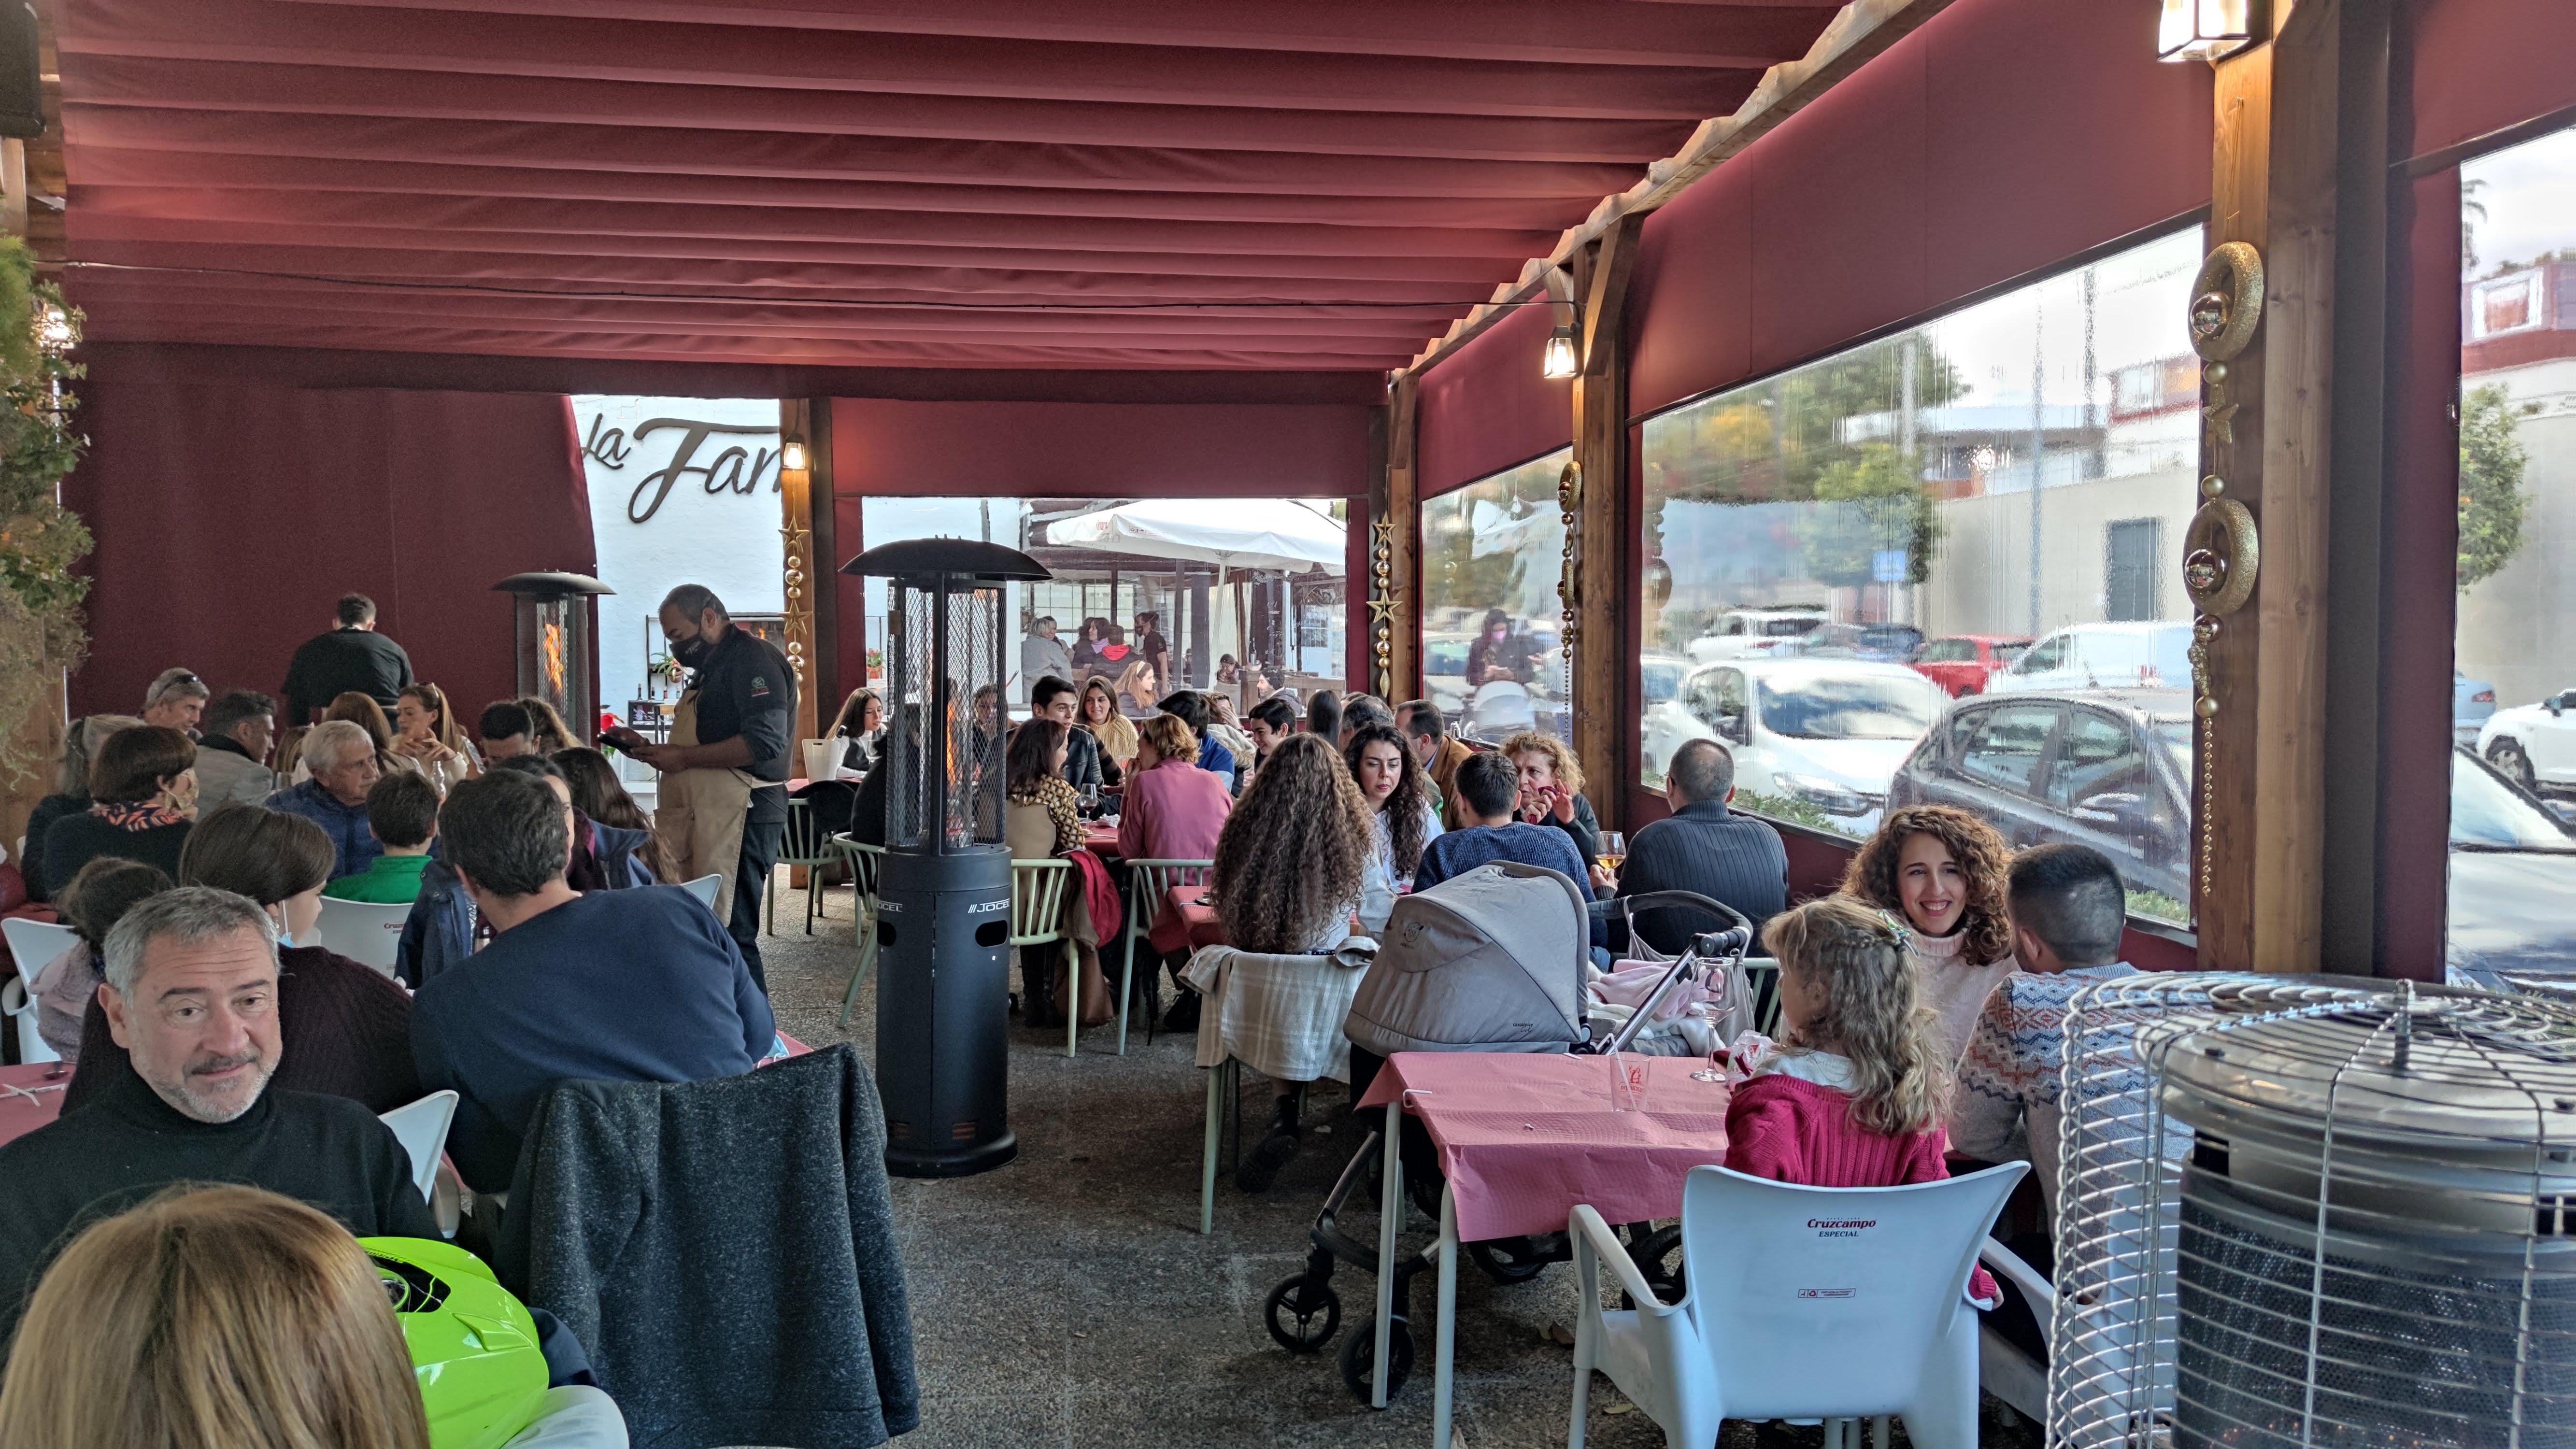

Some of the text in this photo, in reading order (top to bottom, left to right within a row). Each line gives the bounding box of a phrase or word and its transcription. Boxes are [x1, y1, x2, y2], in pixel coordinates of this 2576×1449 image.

[582, 413, 631, 469] La
[877, 900, 903, 912] OCEL
[977, 898, 1010, 912] JOCEL
[1807, 1219, 1876, 1229] Cruzcampo
